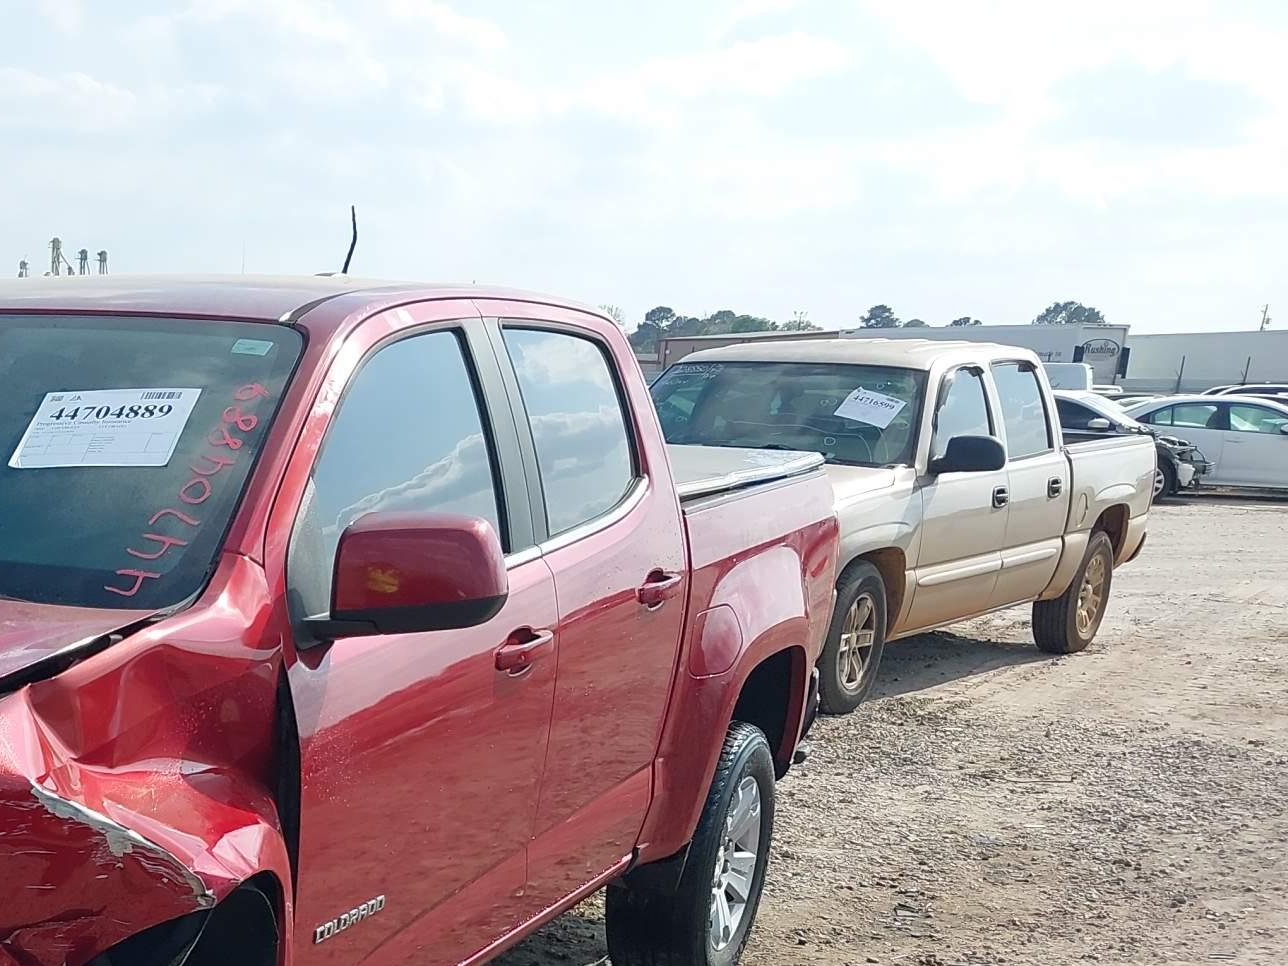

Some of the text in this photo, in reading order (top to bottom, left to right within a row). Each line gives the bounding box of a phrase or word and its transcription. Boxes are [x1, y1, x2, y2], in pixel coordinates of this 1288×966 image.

[49, 404, 173, 421] 44704889
[853, 394, 895, 410] 44716599
[104, 383, 268, 597] 44704889
[313, 895, 385, 944] COLORADO
